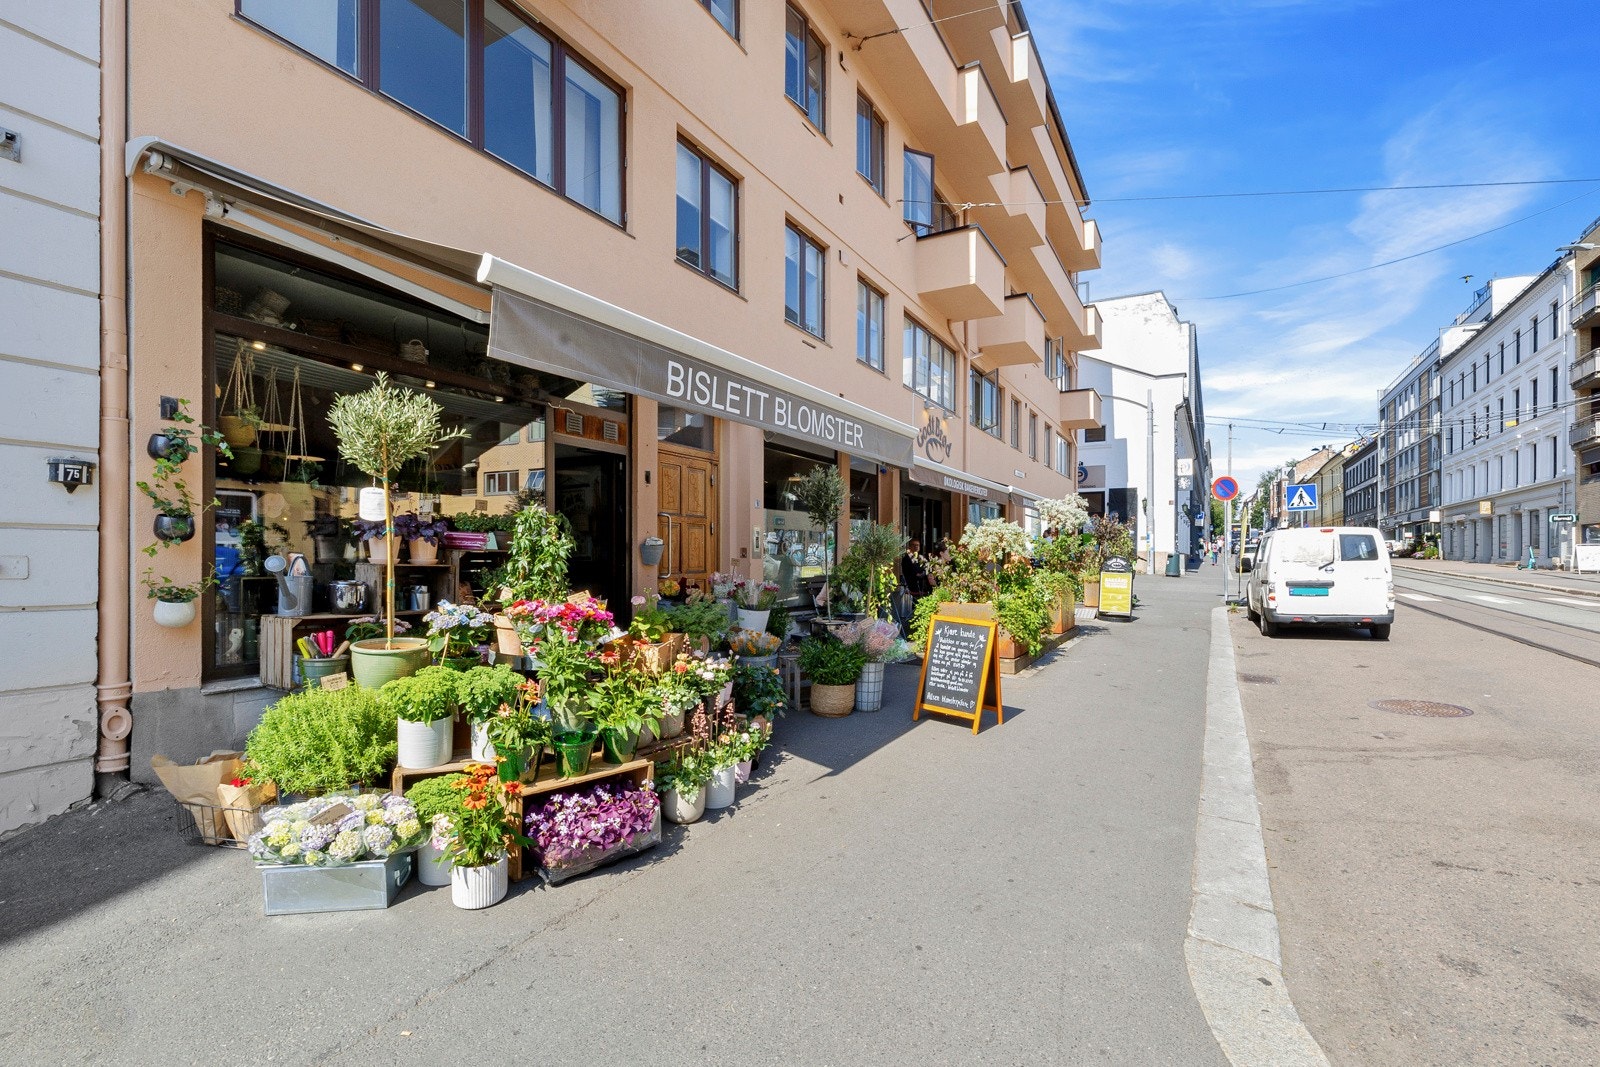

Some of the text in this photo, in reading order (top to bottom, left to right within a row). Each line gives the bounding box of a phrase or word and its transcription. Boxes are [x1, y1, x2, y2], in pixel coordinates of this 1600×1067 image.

[666, 360, 864, 449] BISLETT BLOMSTER
[66, 468, 80, 481] 75
